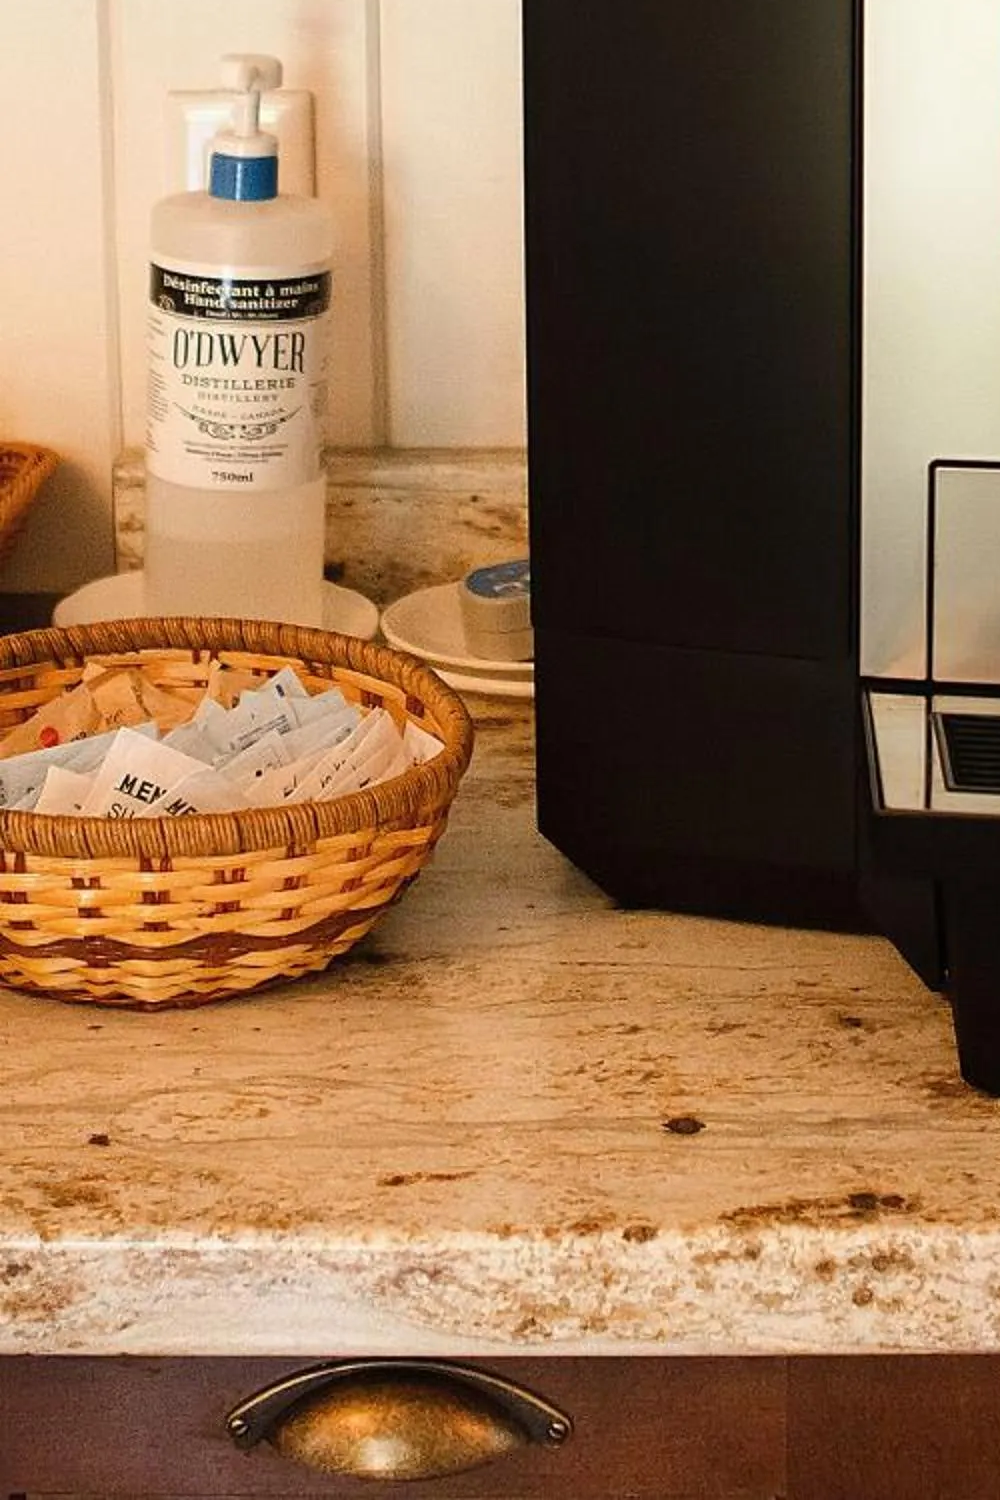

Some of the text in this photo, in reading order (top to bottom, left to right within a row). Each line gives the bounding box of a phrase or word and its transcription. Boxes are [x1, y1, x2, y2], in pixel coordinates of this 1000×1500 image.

[184, 291, 226, 309] Hand
[173, 327, 306, 375] O'DWYER
[181, 373, 297, 392] DISTILLERIE
